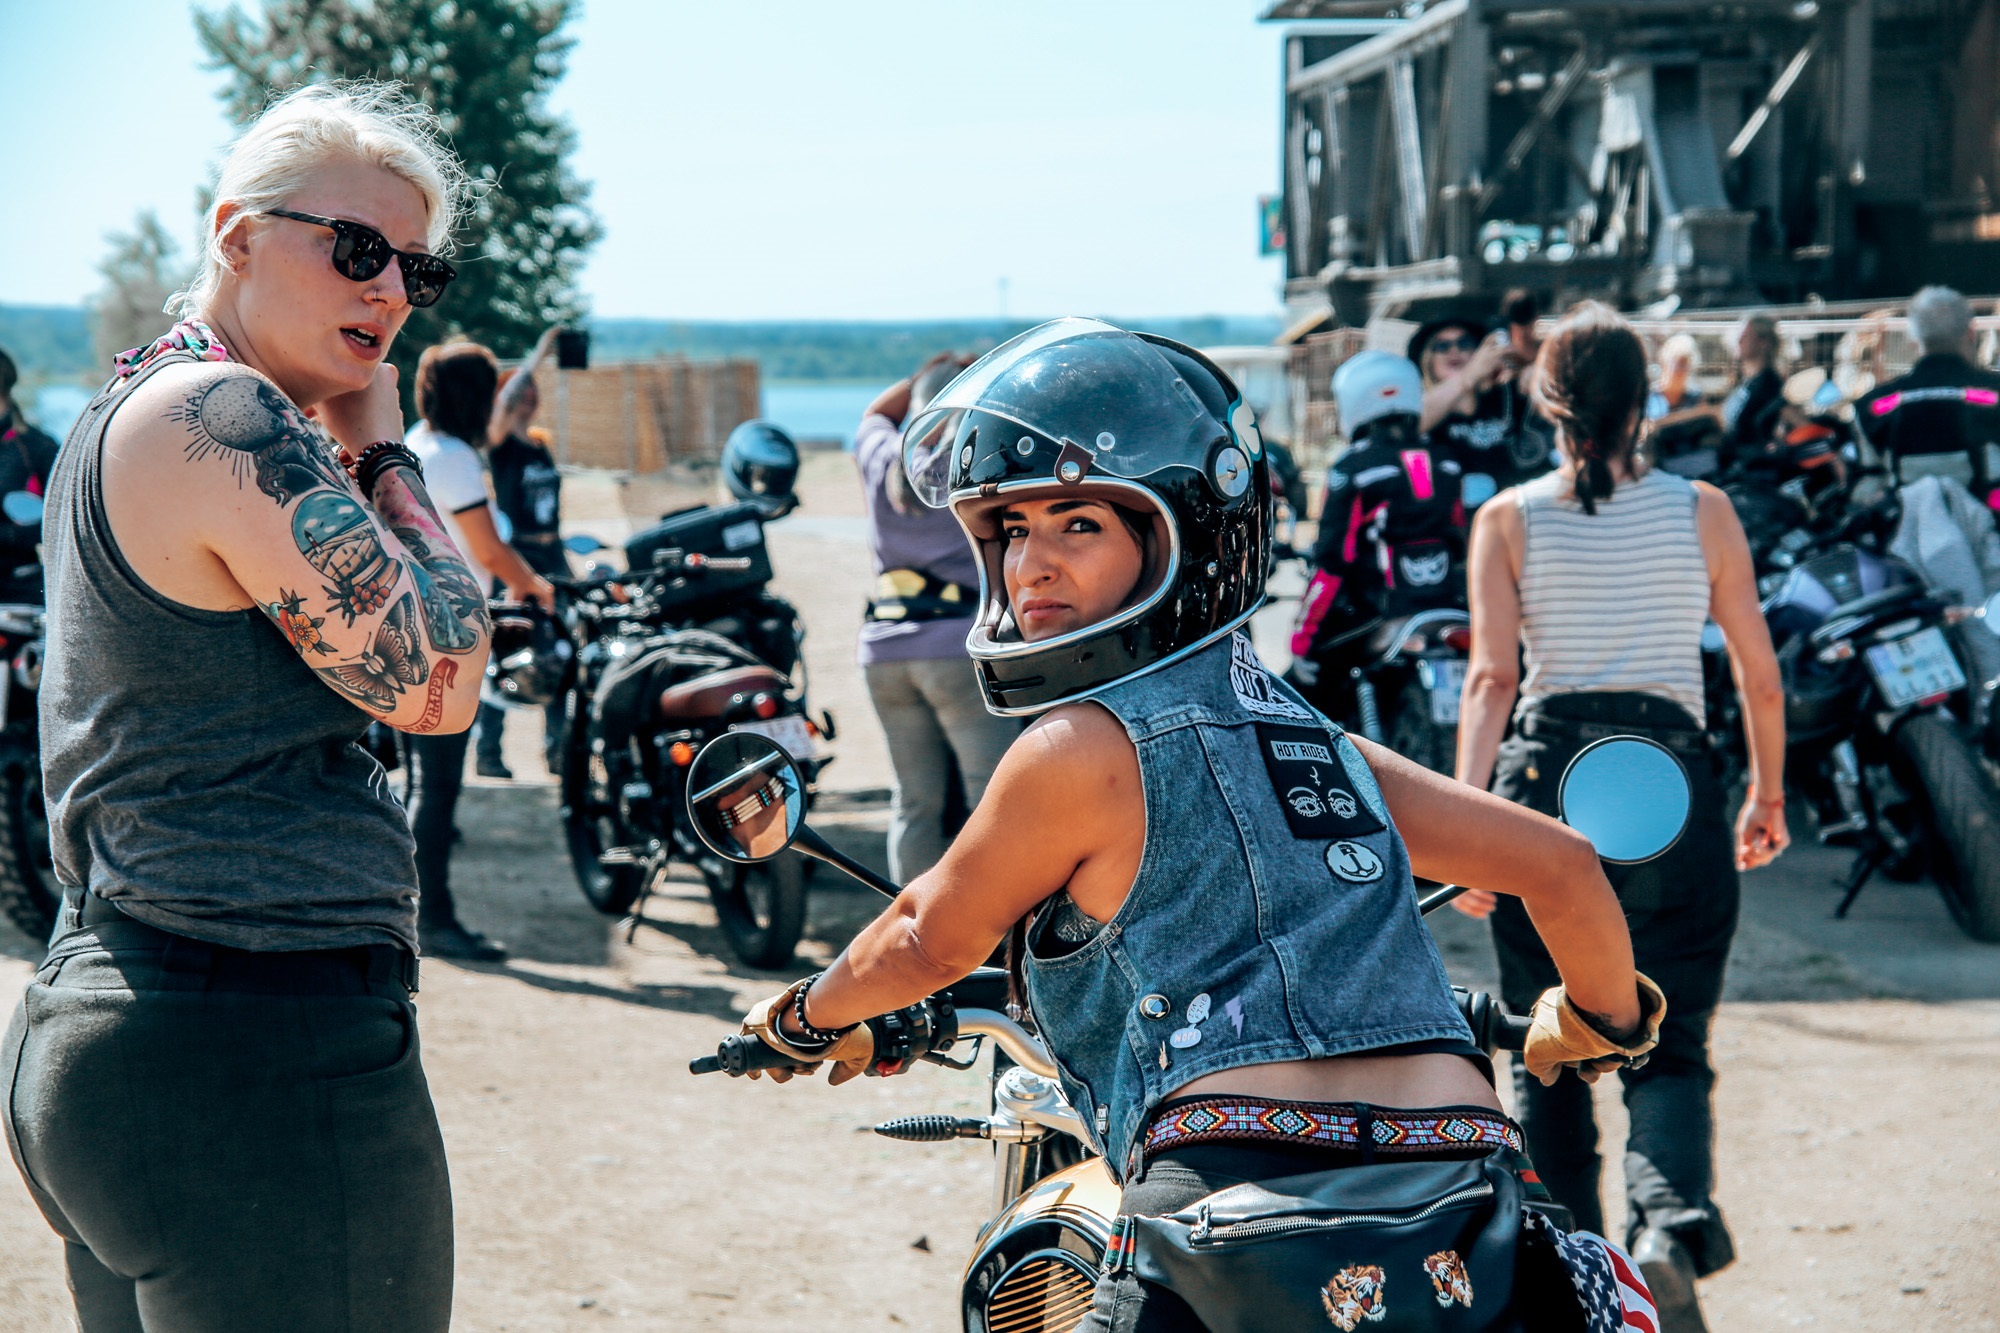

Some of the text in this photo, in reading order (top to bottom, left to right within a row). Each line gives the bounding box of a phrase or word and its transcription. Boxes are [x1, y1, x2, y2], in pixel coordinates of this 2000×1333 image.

[427, 671, 444, 719] HAPPY
[1276, 744, 1329, 760] HOT RIDES
[1195, 996, 1208, 1019] FINE
[1174, 1031, 1198, 1043] NOPE
